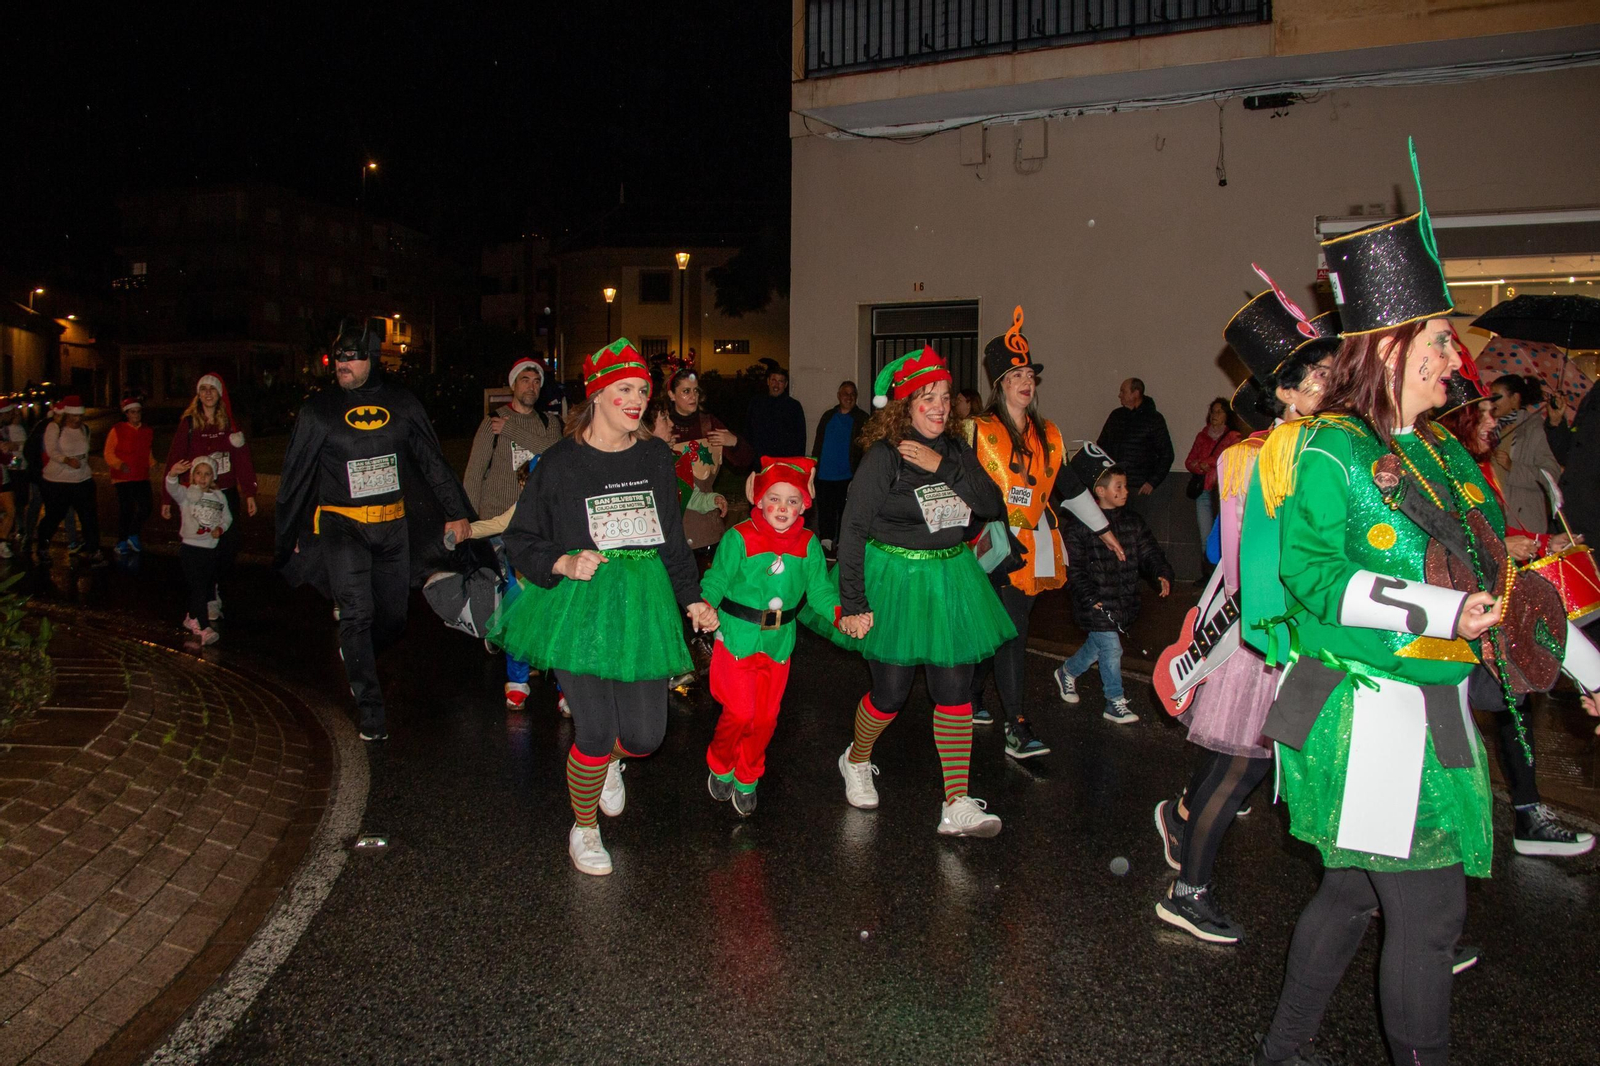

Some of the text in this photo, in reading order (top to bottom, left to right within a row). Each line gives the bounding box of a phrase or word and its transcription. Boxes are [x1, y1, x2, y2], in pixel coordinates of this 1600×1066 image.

[914, 282, 924, 291] 16
[357, 472, 394, 490] 1435
[1011, 487, 1031, 498] Dando
[611, 494, 644, 504] SILVESTRE
[1012, 495, 1028, 504] Nota
[933, 503, 960, 522] 891
[606, 517, 647, 538] 890
